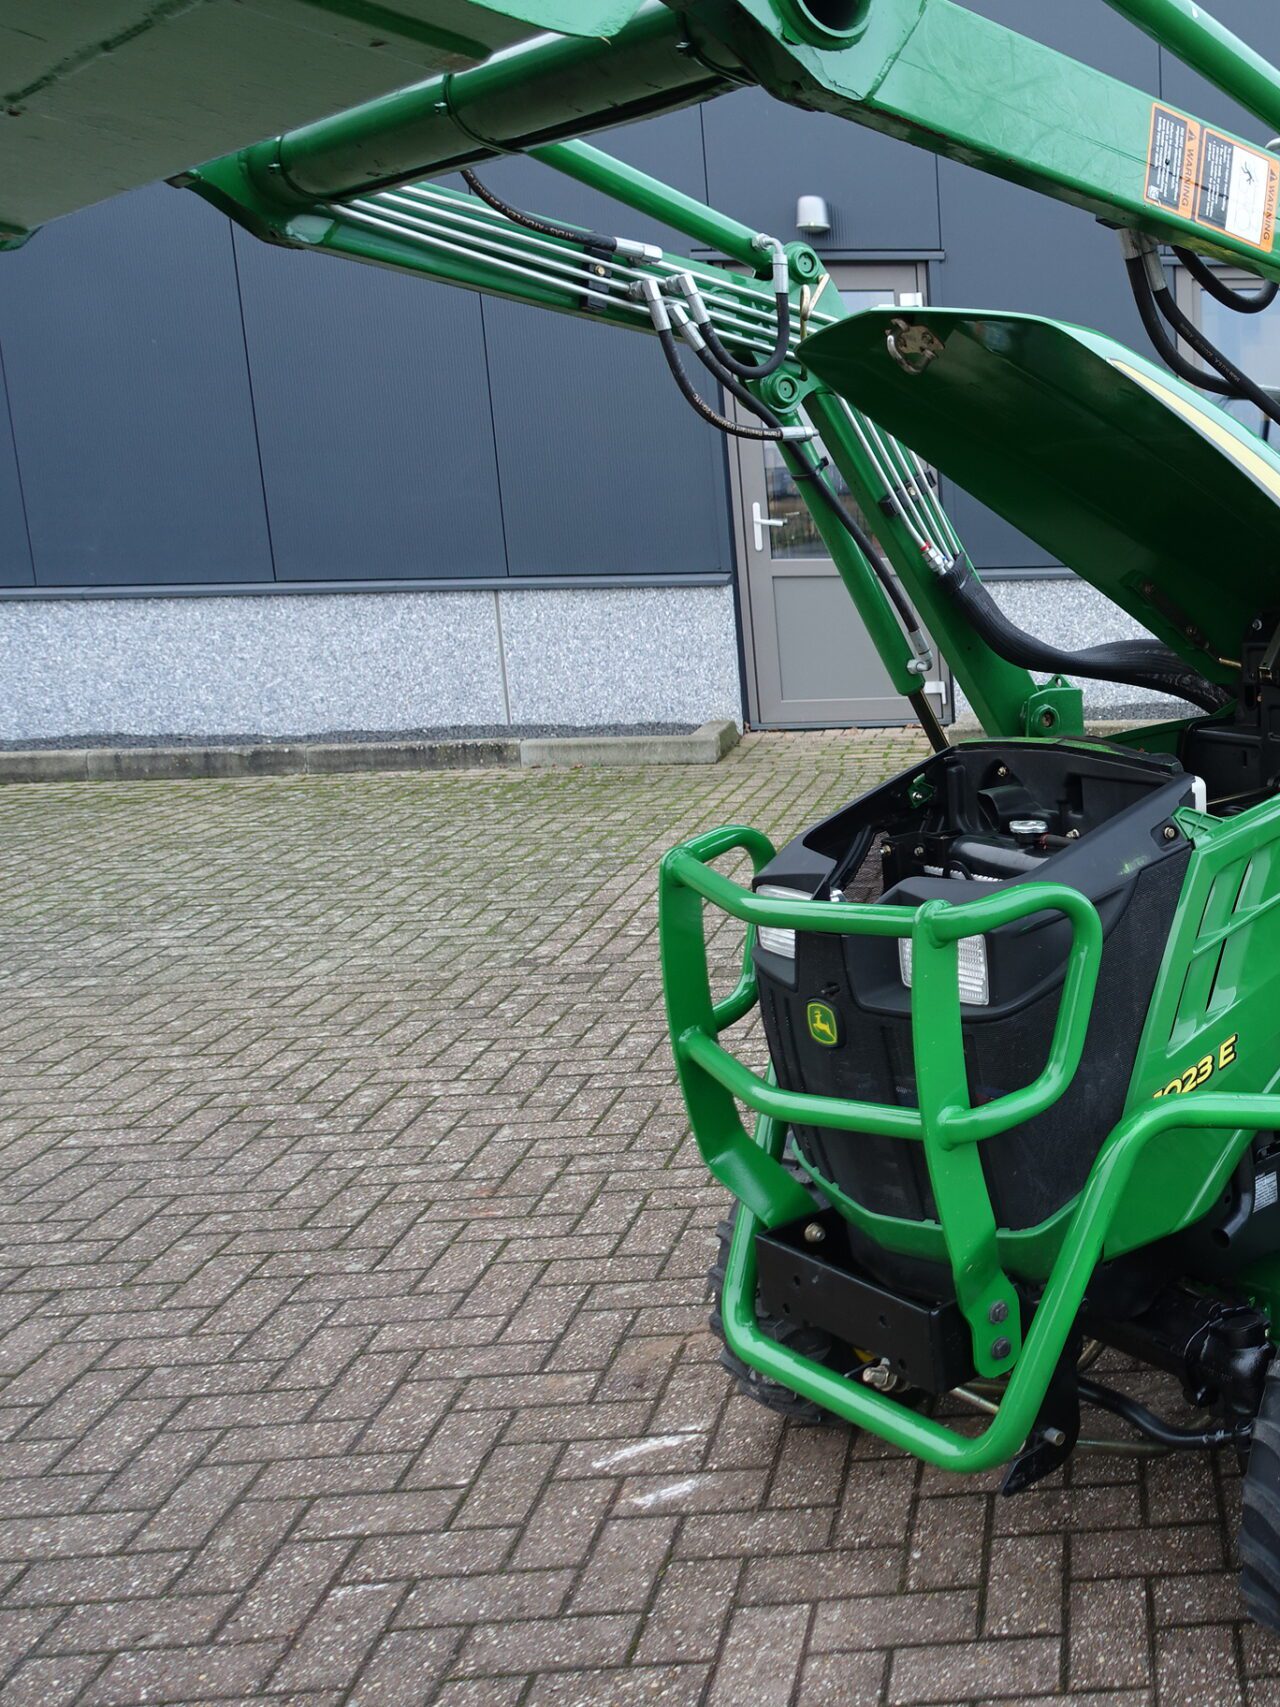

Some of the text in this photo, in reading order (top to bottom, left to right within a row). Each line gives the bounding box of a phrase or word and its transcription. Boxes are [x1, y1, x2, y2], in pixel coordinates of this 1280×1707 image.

[1181, 149, 1196, 207] WARNING
[1263, 185, 1278, 241] WARNING
[1218, 1033, 1238, 1071] E
